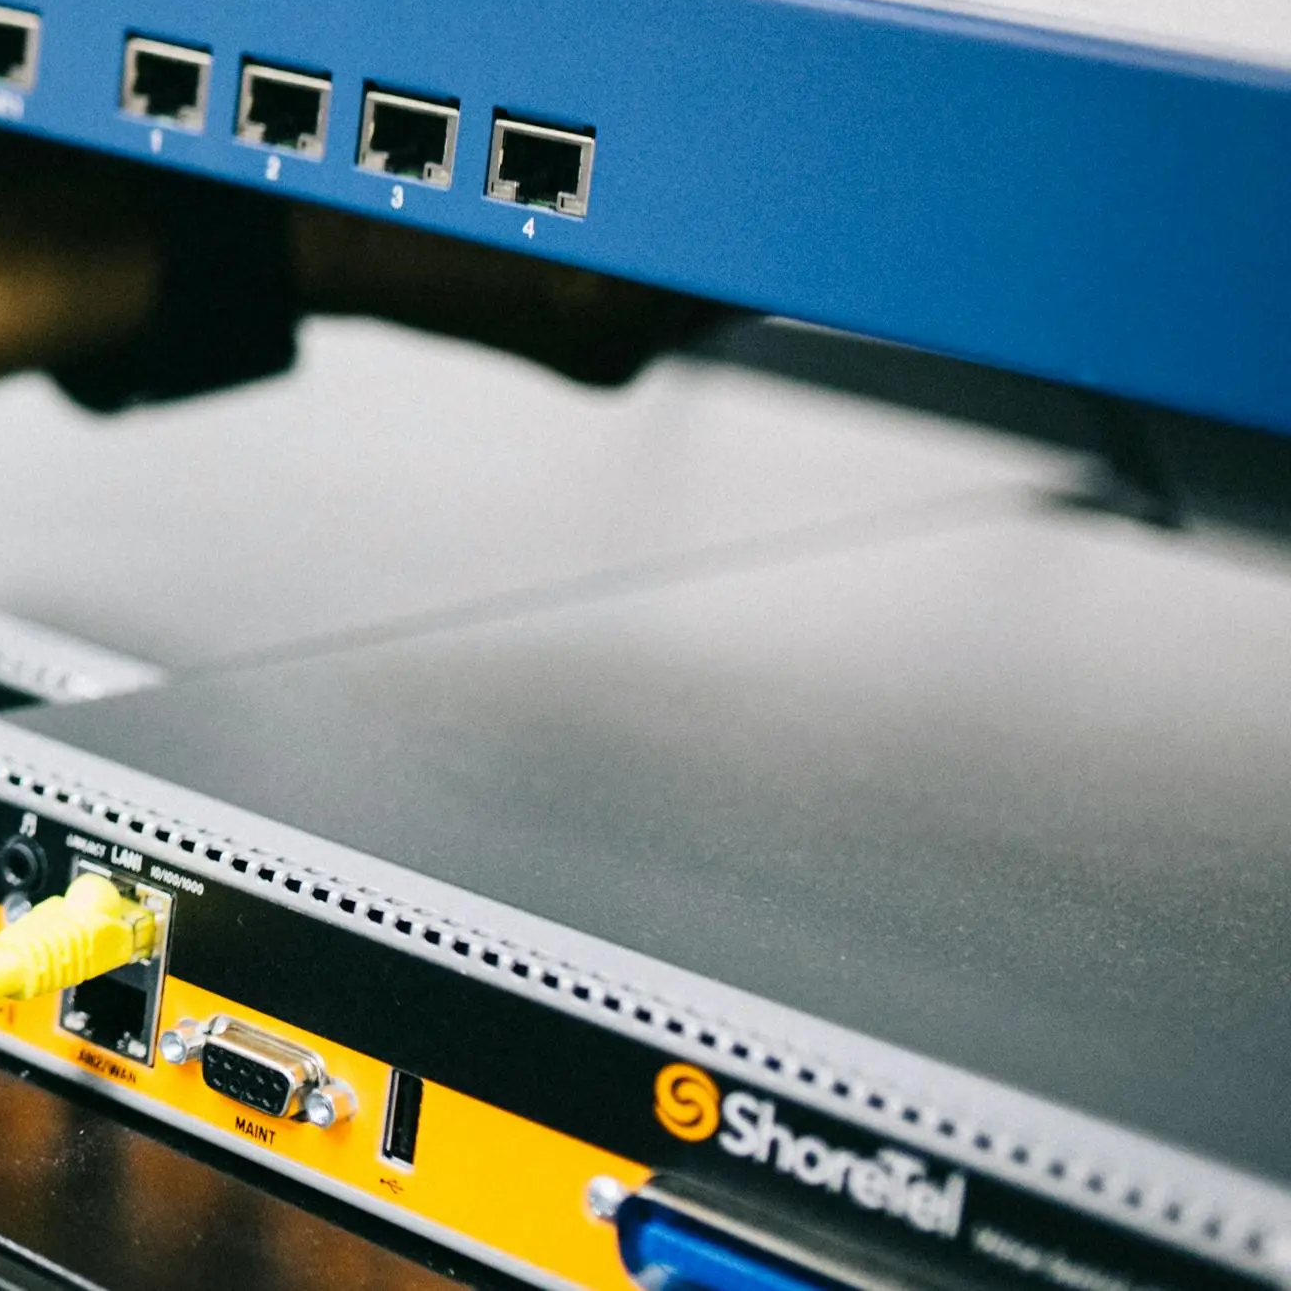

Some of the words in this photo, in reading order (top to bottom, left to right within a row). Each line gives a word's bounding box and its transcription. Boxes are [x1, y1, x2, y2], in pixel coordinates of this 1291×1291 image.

[265, 156, 281, 181] 2
[390, 184, 405, 210] 3
[521, 217, 536, 240] 4
[234, 1115, 277, 1146] MAINT
[719, 1091, 967, 1240] ShoreTel
